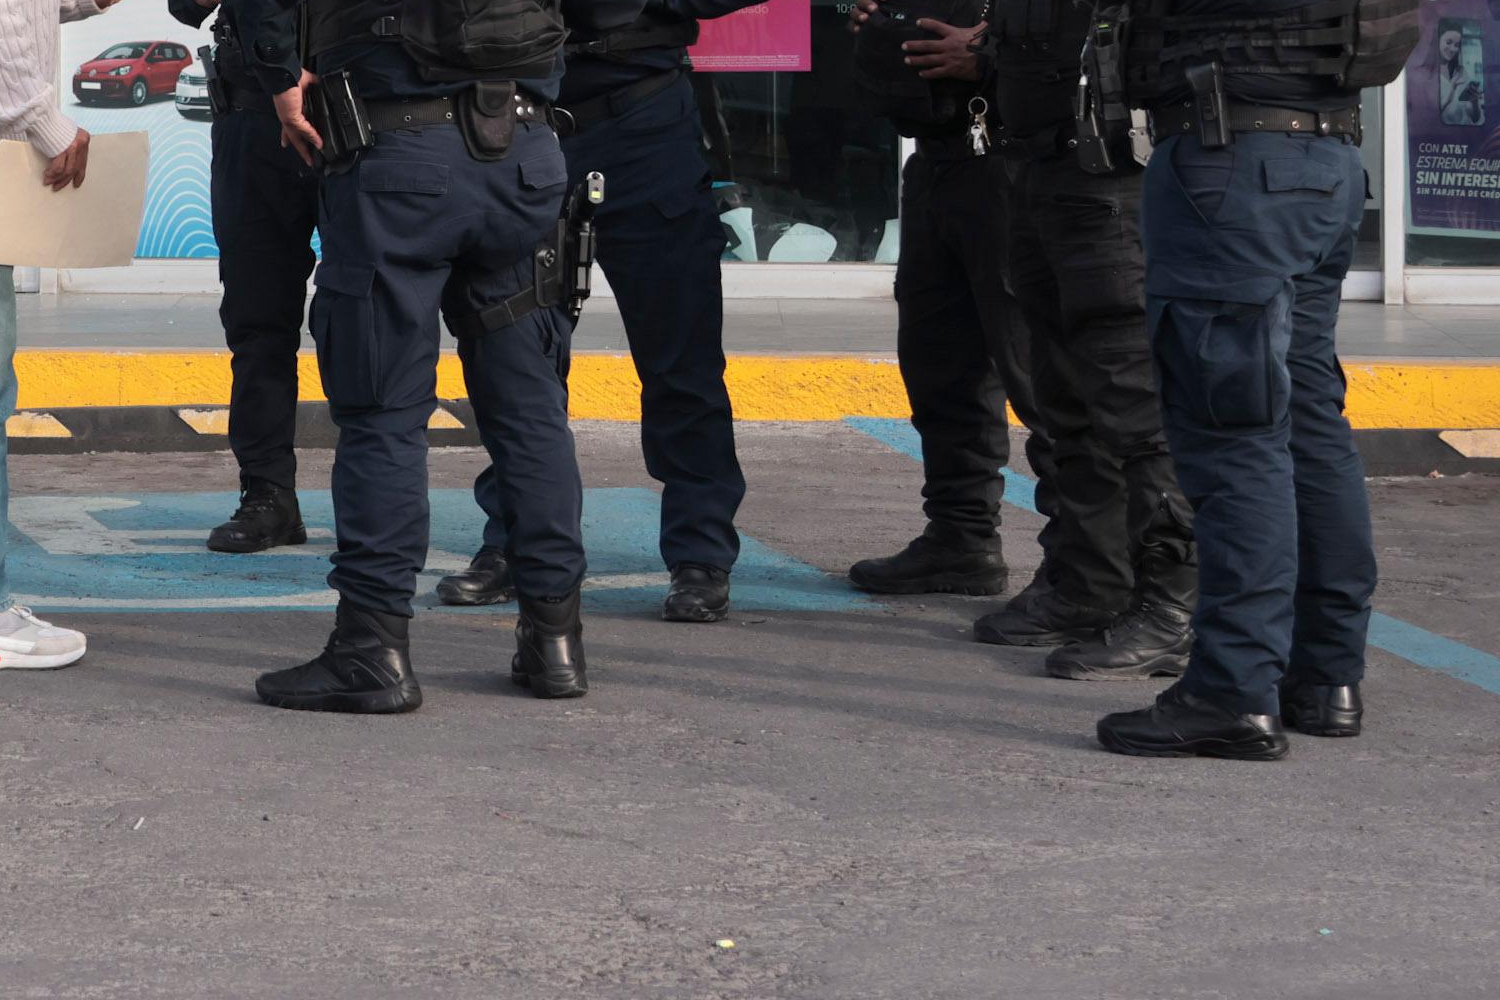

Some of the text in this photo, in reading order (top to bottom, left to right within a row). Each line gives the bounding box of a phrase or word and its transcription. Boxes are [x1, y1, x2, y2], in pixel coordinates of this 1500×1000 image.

[1419, 143, 1468, 155] CON AT&T
[1417, 156, 1466, 169] ESTRENA
[1416, 171, 1440, 185] SIN
[1417, 187, 1430, 195] SIN
[1432, 188, 1465, 197] TARJETA
[1468, 189, 1479, 197] DE
